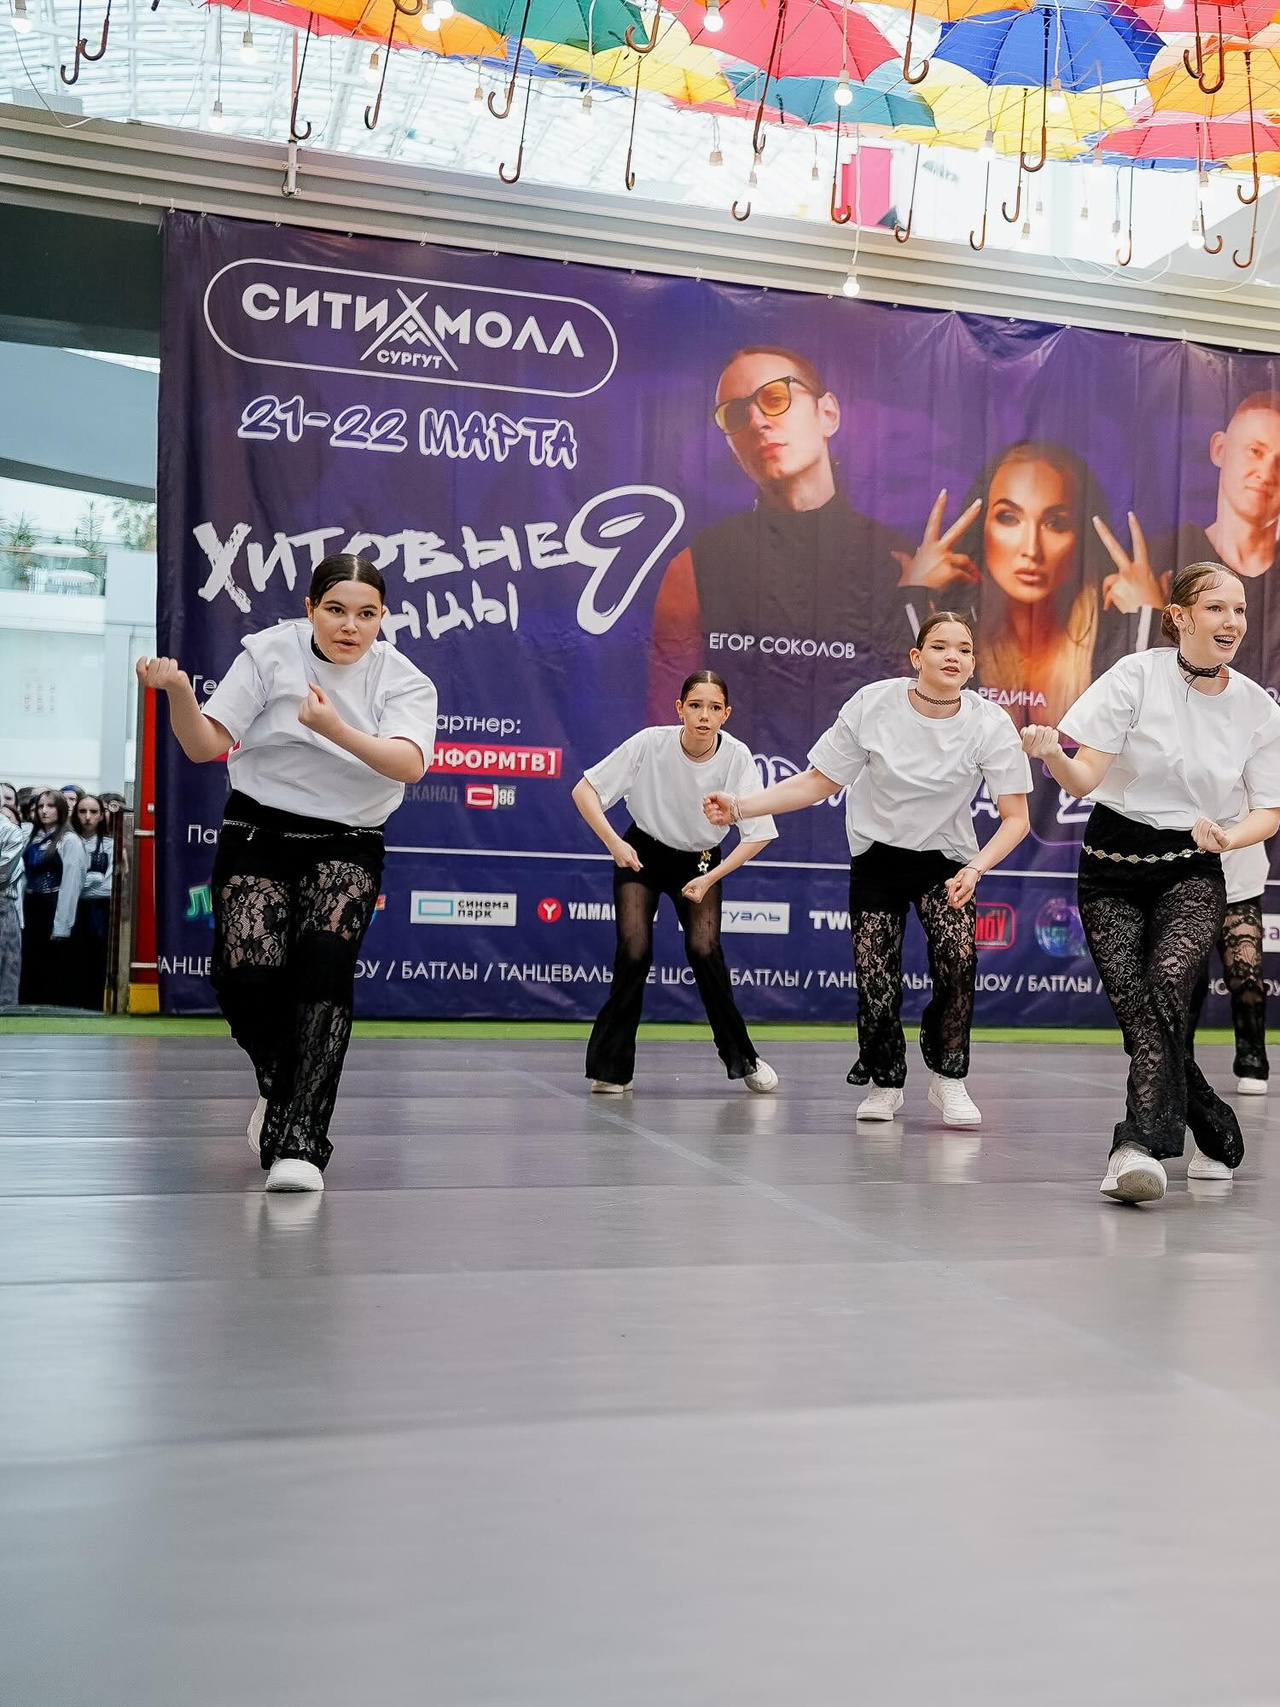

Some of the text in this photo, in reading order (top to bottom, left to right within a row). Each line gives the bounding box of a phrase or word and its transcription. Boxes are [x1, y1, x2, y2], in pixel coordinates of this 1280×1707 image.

[376, 348, 442, 370] СУРГУТ
[237, 395, 579, 470] 21-22 МАРТА
[709, 632, 856, 660] ЕГОР СОКОЛОВ
[436, 714, 521, 737] артнер:
[458, 899, 509, 910] синема
[458, 909, 492, 919] парк
[402, 961, 478, 980] БАТТЛЫ
[730, 968, 799, 988] БАТТЛЫ
[1028, 975, 1092, 993] БАТТЛЫ
